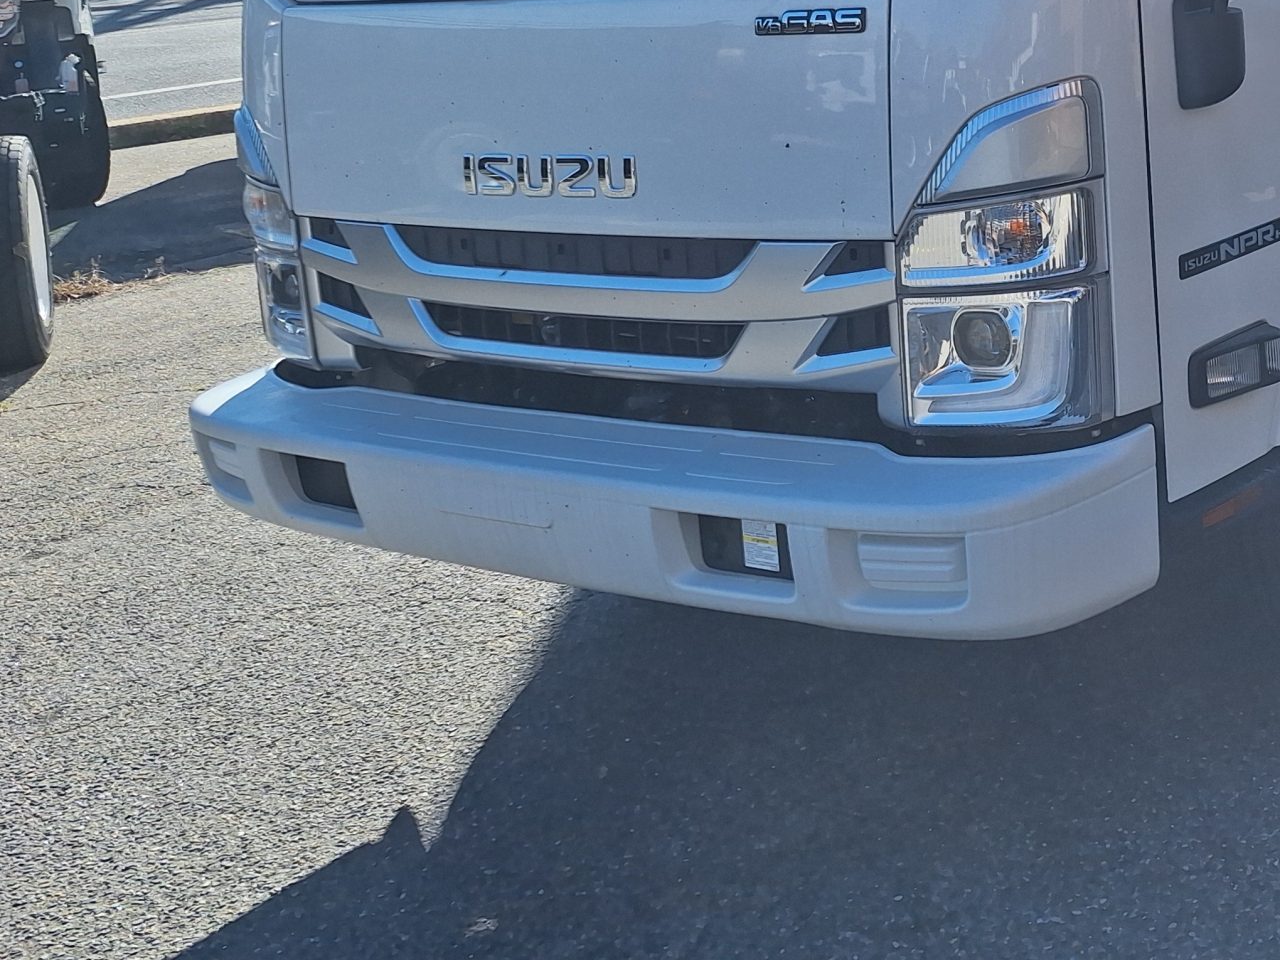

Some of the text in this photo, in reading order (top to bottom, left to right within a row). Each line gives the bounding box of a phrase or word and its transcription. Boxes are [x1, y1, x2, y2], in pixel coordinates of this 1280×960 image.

[781, 10, 862, 34] GAS
[463, 153, 638, 198] ISUZU
[1184, 250, 1218, 272] ISUZU
[1219, 224, 1275, 262] NPR
